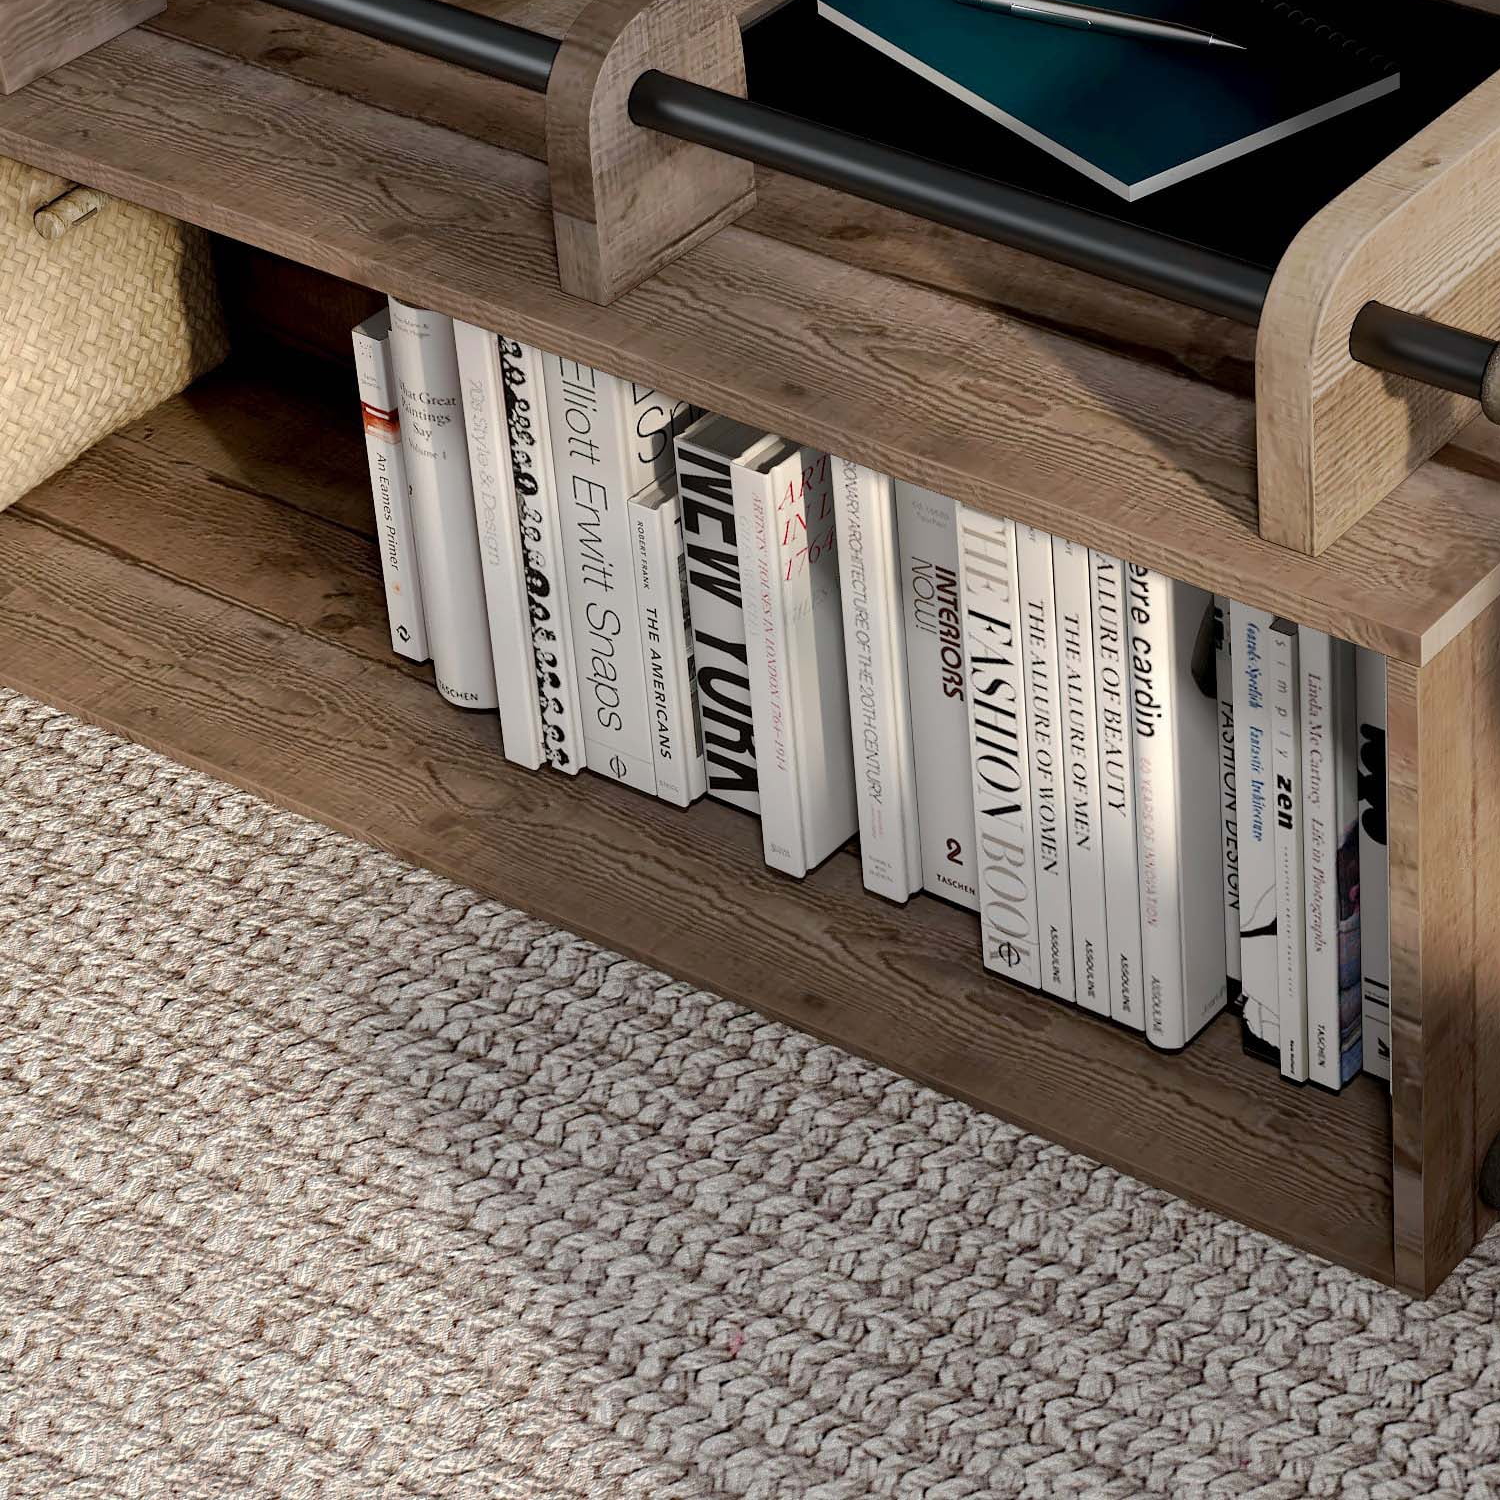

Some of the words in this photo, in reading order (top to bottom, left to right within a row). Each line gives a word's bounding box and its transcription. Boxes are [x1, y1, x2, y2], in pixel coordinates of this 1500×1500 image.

[419, 391, 457, 406] Great
[559, 356, 601, 465] Elliott
[413, 423, 433, 442] Say
[375, 452, 387, 472] An
[778, 452, 832, 510] ART
[378, 475, 392, 522] Eames
[386, 525, 399, 571] Primer
[572, 475, 615, 592] Erwitt
[637, 520, 647, 559] ROBERT
[641, 560, 650, 590] FRANK
[911, 556, 938, 635] NOW!
[1128, 562, 1151, 625] erre
[646, 607, 660, 643] THE
[935, 566, 964, 702] INTERIORS
[1028, 600, 1046, 649] THE
[1064, 613, 1082, 662] THE
[438, 680, 479, 701] TASCHEN
[586, 602, 622, 732] Snaps
[1102, 665, 1121, 706] OF
[1131, 635, 1162, 739] cardin
[650, 647, 672, 760] AMERICANS
[967, 604, 1025, 831] FASHION
[1030, 651, 1052, 747] ALLURE
[1066, 665, 1087, 760] ALLURE
[1307, 672, 1323, 717] Linda
[863, 727, 884, 804] CENTURY
[1035, 748, 1054, 781] OF
[1072, 761, 1089, 795] OF
[1103, 707, 1127, 818] BEAUTY
[1073, 797, 1091, 851] MEN
[1277, 774, 1293, 830] zen
[945, 838, 964, 866] 2
[1039, 785, 1060, 877] WOMEN
[936, 874, 976, 896] TASCHEN
